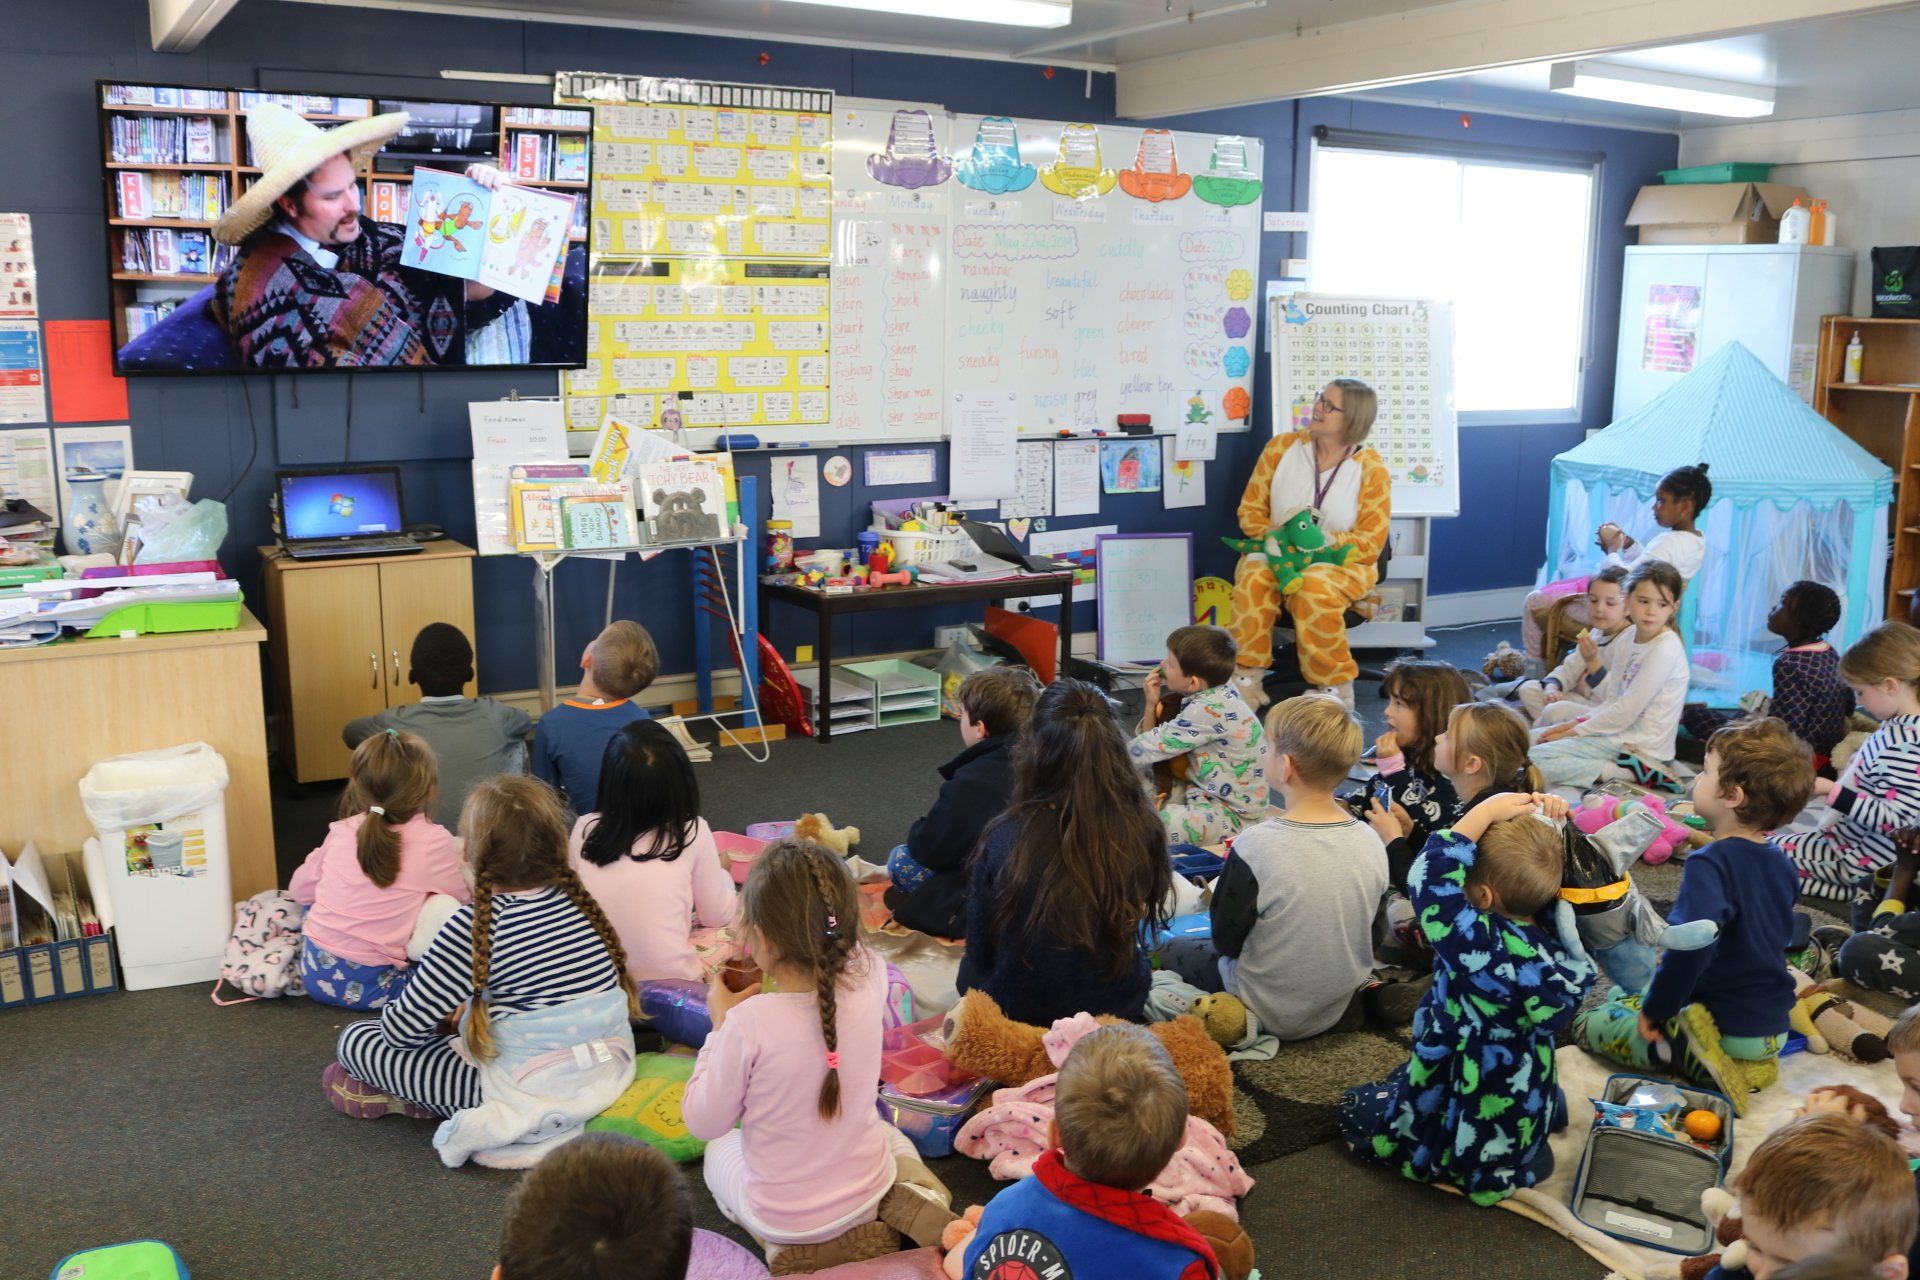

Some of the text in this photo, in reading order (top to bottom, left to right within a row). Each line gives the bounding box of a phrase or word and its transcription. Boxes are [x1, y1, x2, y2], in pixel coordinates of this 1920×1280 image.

[889, 195, 933, 214] Monday
[966, 202, 1007, 219] Tuesday
[1056, 204, 1105, 223] Wednesday
[1132, 208, 1175, 225] Thursday
[1205, 210, 1232, 225] Friday
[1046, 269, 1099, 297] beautiful
[960, 280, 1017, 314] naughty
[1046, 299, 1077, 329] soft
[1305, 303, 1409, 317] Counting Chart
[958, 346, 1000, 383] sneaky
[1018, 336, 1059, 375] funny
[1120, 374, 1152, 405] yellow
[600, 429, 622, 464] Health
[1185, 433, 1207, 452] frog
[680, 471, 710, 485] BEAR
[579, 512, 589, 538] Jesus
[594, 507, 604, 541] Growing
[1197, 585, 1204, 593] 11
